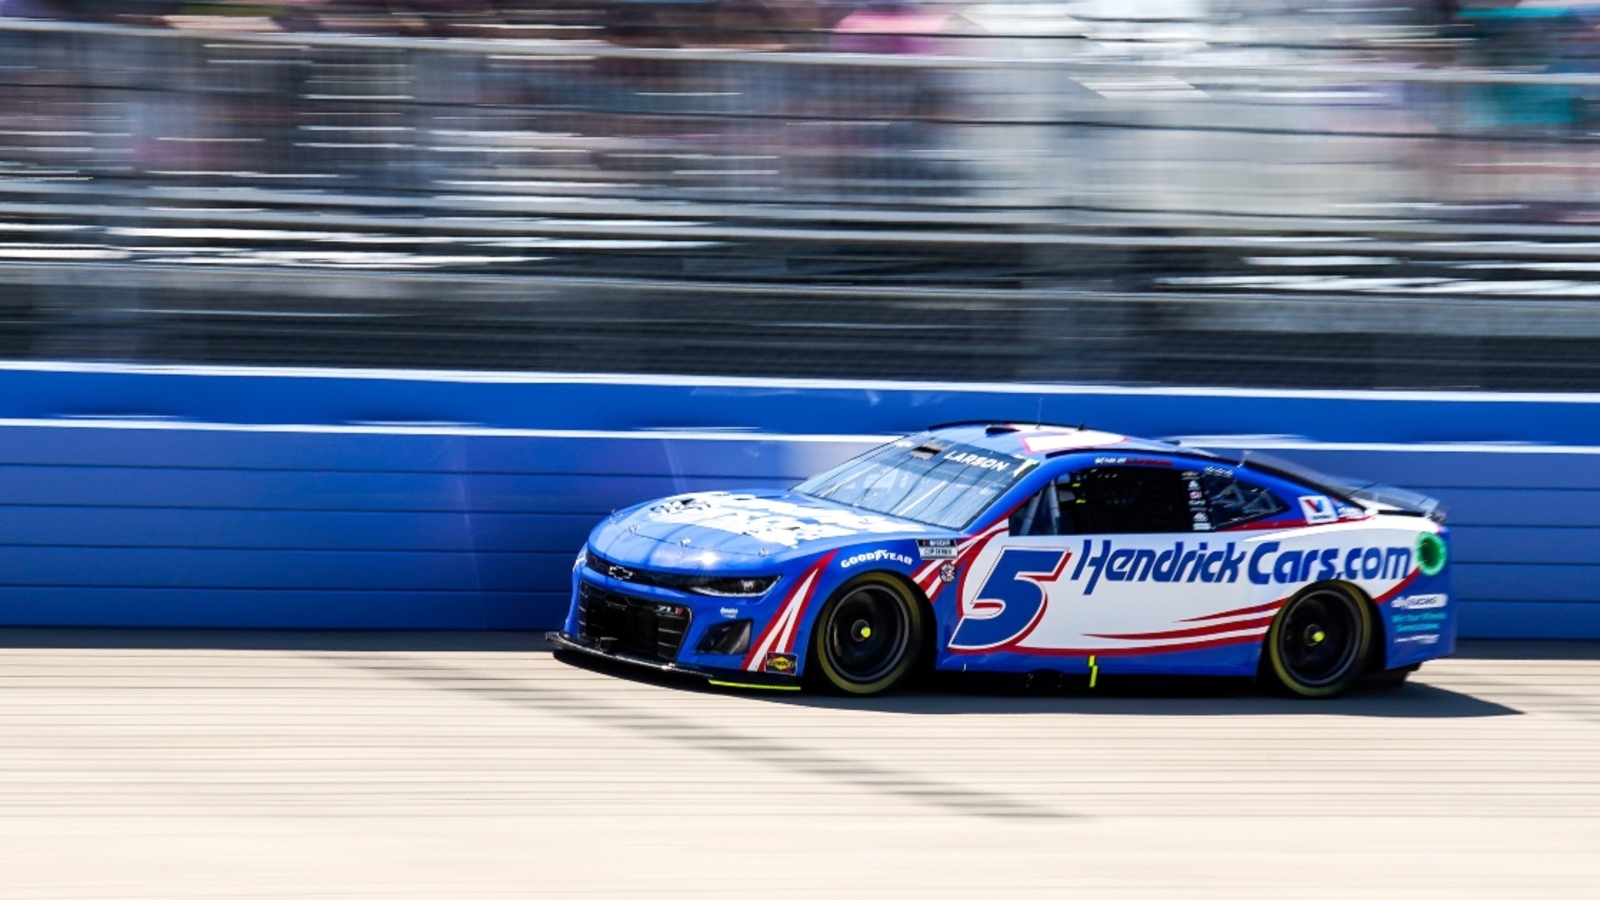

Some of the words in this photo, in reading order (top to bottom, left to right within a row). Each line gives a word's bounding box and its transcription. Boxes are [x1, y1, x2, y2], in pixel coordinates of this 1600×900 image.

[943, 450, 1010, 471] LARSON
[840, 549, 914, 568] GOODYEAR
[949, 547, 1070, 652] 5
